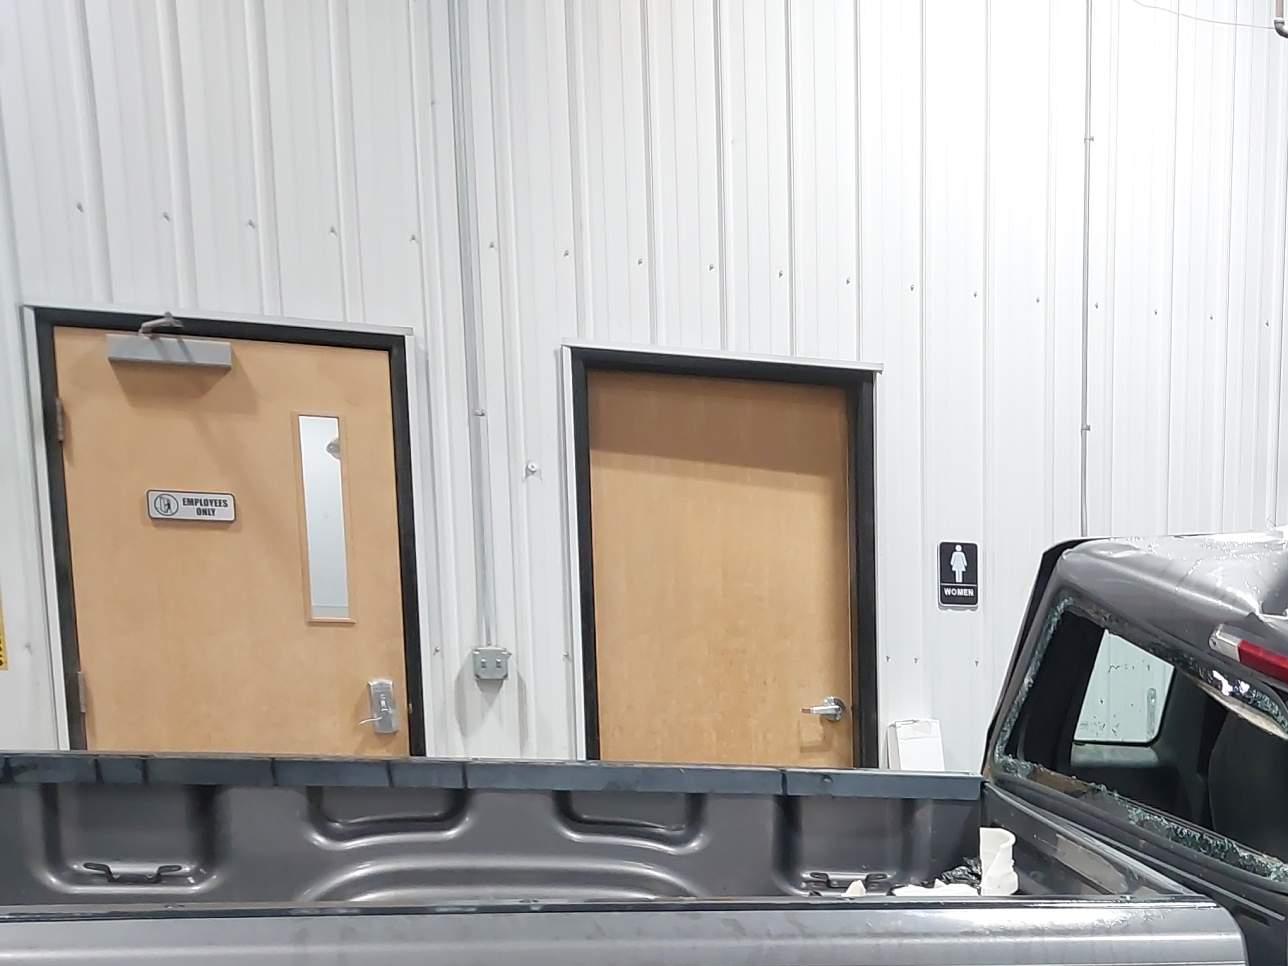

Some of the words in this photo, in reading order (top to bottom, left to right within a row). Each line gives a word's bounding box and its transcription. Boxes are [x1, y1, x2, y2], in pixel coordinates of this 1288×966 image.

[182, 497, 228, 508] EMPLOYEES
[196, 507, 216, 516] ONLY
[943, 587, 975, 597] WOMEN
